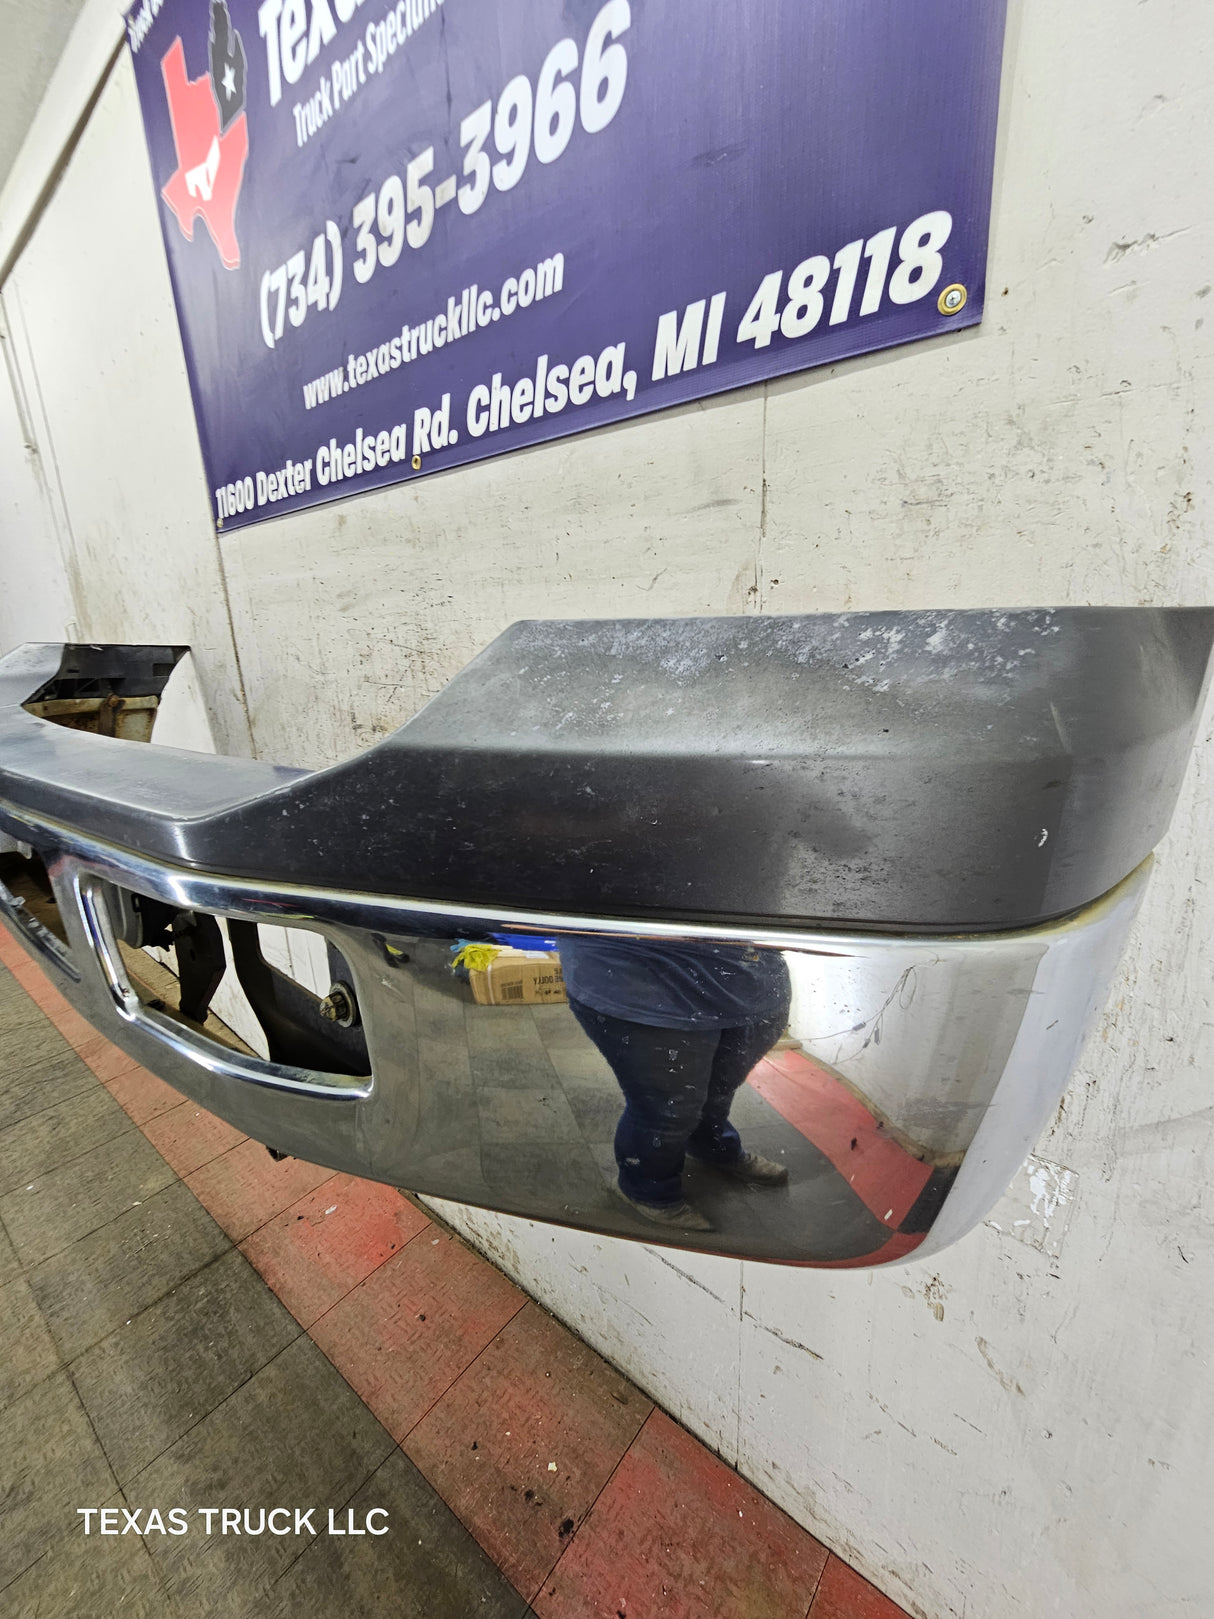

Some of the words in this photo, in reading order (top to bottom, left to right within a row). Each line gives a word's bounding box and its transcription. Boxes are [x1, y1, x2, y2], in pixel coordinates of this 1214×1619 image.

[258, 0, 366, 107] Tex
[293, 76, 333, 147] Truck
[331, 39, 366, 110] Part
[259, 220, 343, 348] (734)
[353, 0, 631, 283] 395-3966
[216, 476, 255, 519] 11600
[256, 459, 312, 506] Dexter
[316, 423, 406, 486] Chelsea
[413, 393, 458, 455] Rd.
[466, 342, 637, 437] Chelsea,
[652, 291, 726, 381] MI
[736, 210, 953, 349] 48118
[303, 252, 564, 409] www.texastruckllc.com
